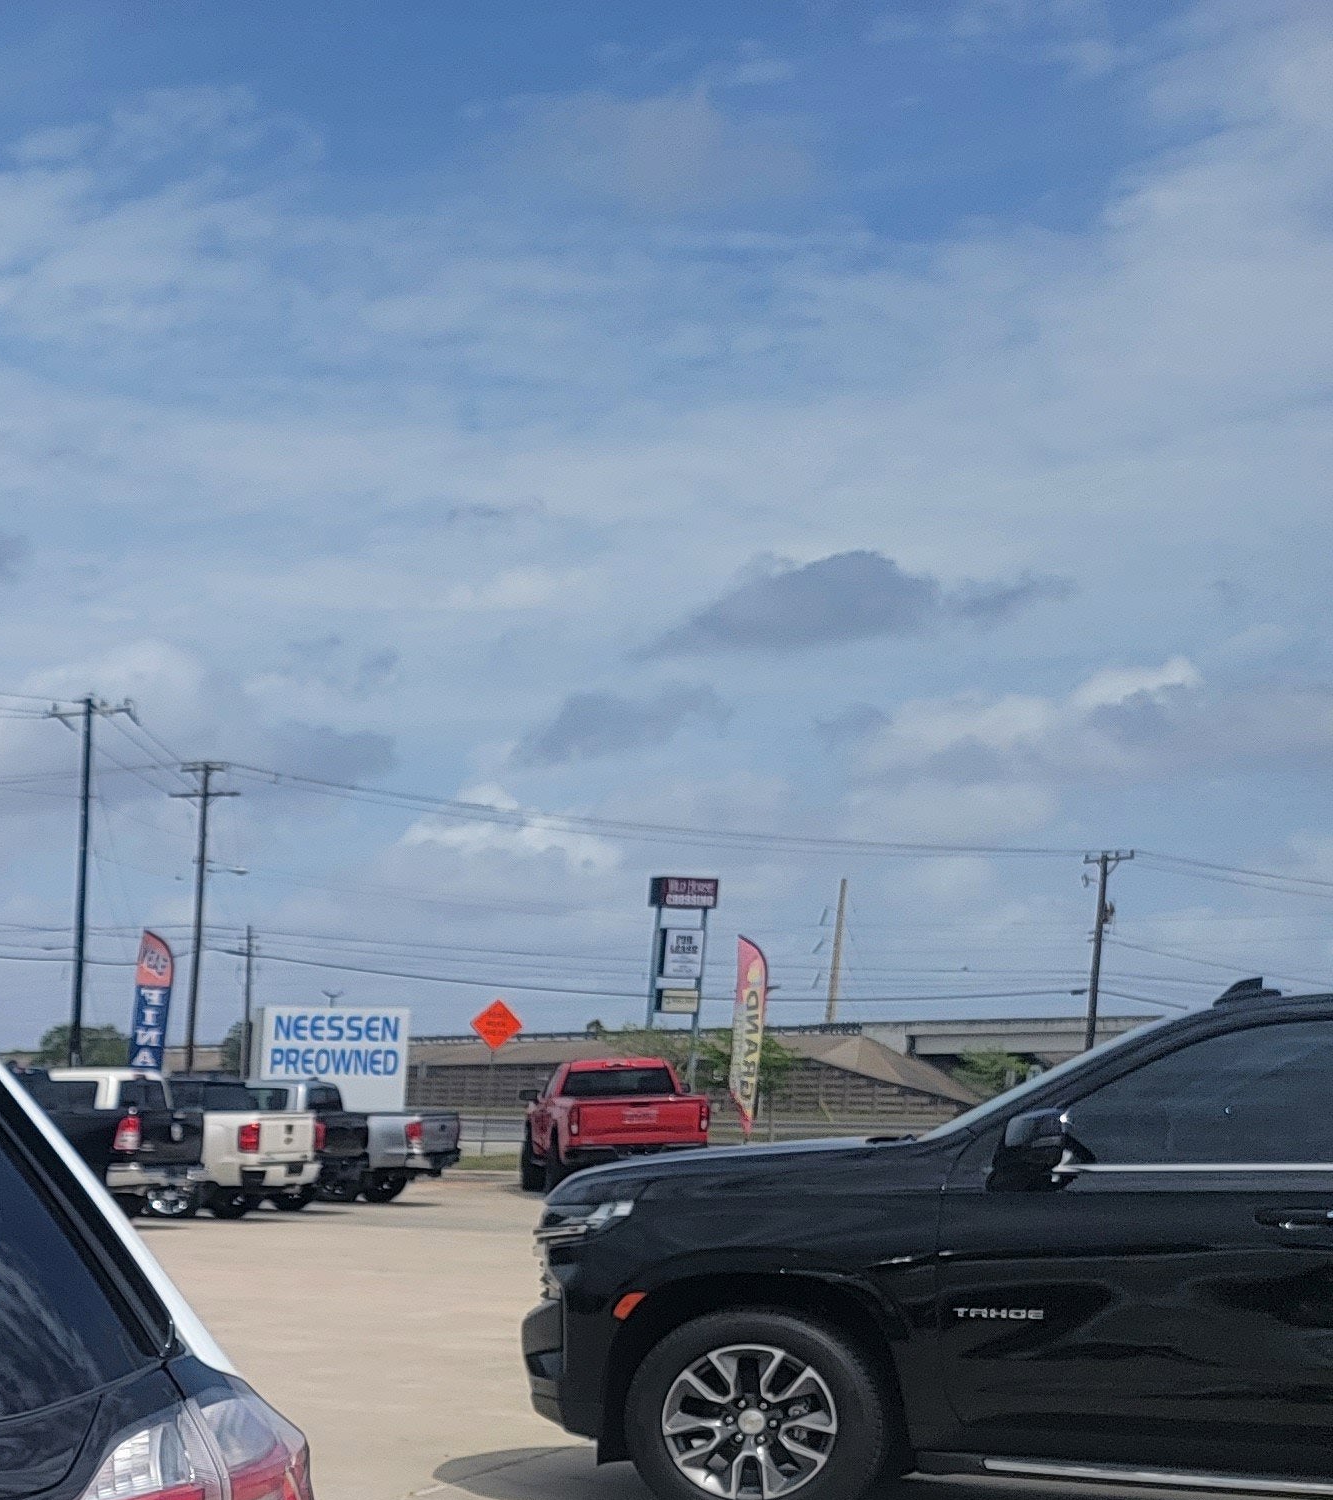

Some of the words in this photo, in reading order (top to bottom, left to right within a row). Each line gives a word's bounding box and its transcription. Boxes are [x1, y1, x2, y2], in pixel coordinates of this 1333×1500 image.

[274, 1014, 400, 1042] NEESSEN
[269, 1048, 399, 1076] PREOWNED
[953, 1307, 1044, 1320] TAHOE
